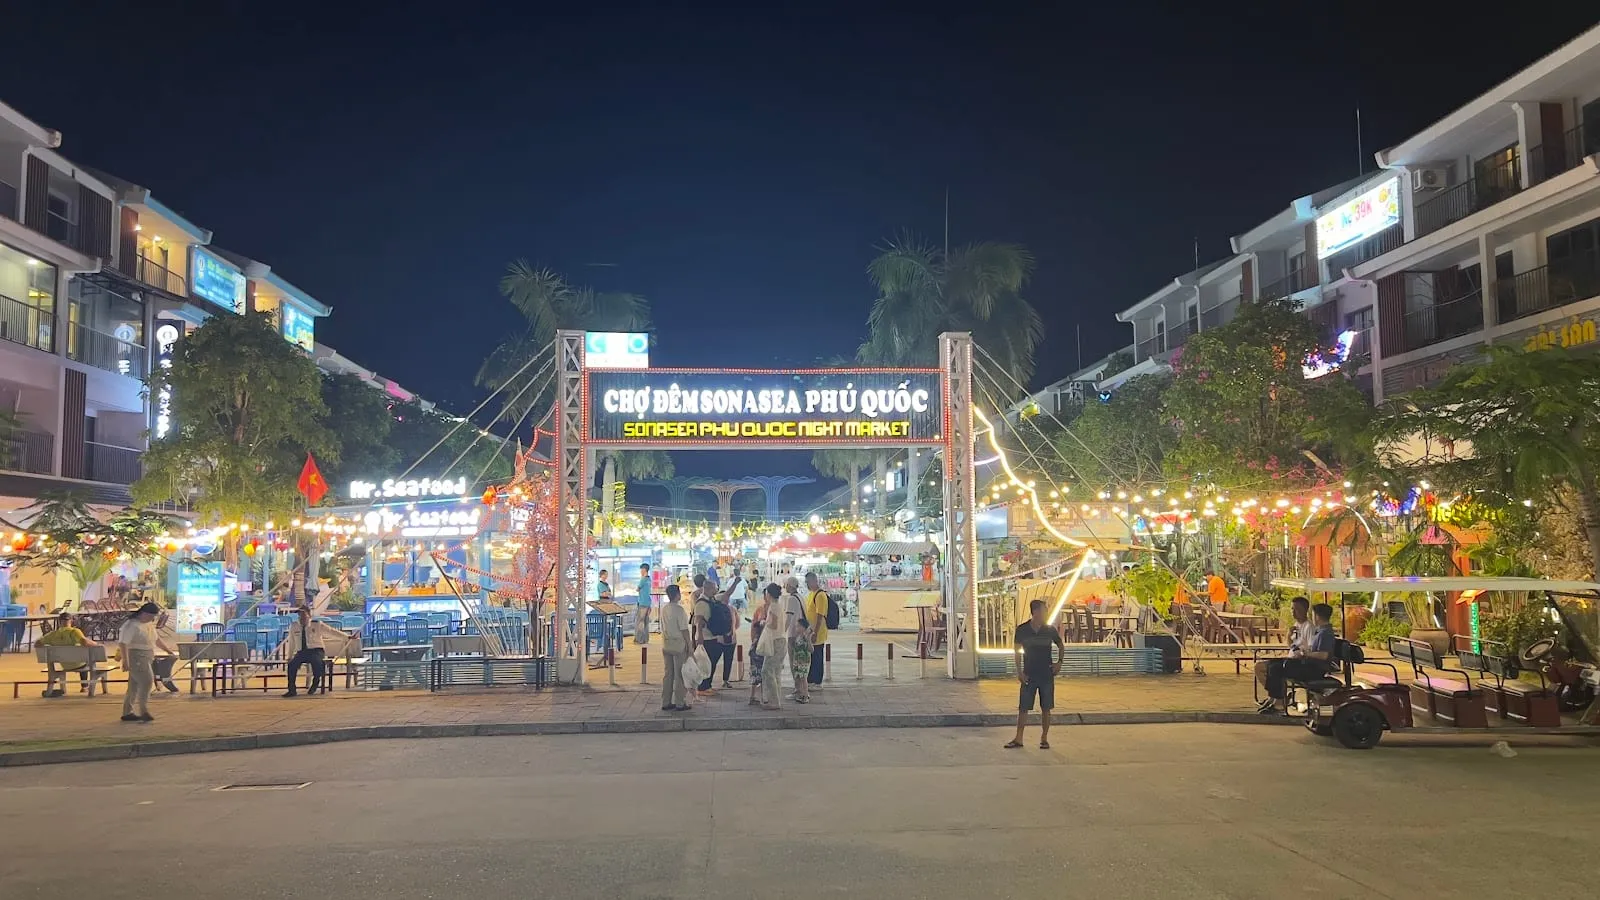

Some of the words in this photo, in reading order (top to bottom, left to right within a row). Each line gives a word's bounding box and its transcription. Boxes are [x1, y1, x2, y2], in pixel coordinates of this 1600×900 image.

[603, 386, 651, 420] CHỢ
[653, 382, 699, 414] ĐÊM
[700, 389, 802, 414] SONASEA
[805, 383, 857, 414] PHÚ
[860, 379, 929, 418] QUỐC
[623, 421, 698, 438] SONASEA
[700, 421, 740, 438] PHU
[741, 421, 797, 438] QUOC
[799, 421, 844, 437] NIGHT
[845, 421, 910, 437] MARKET
